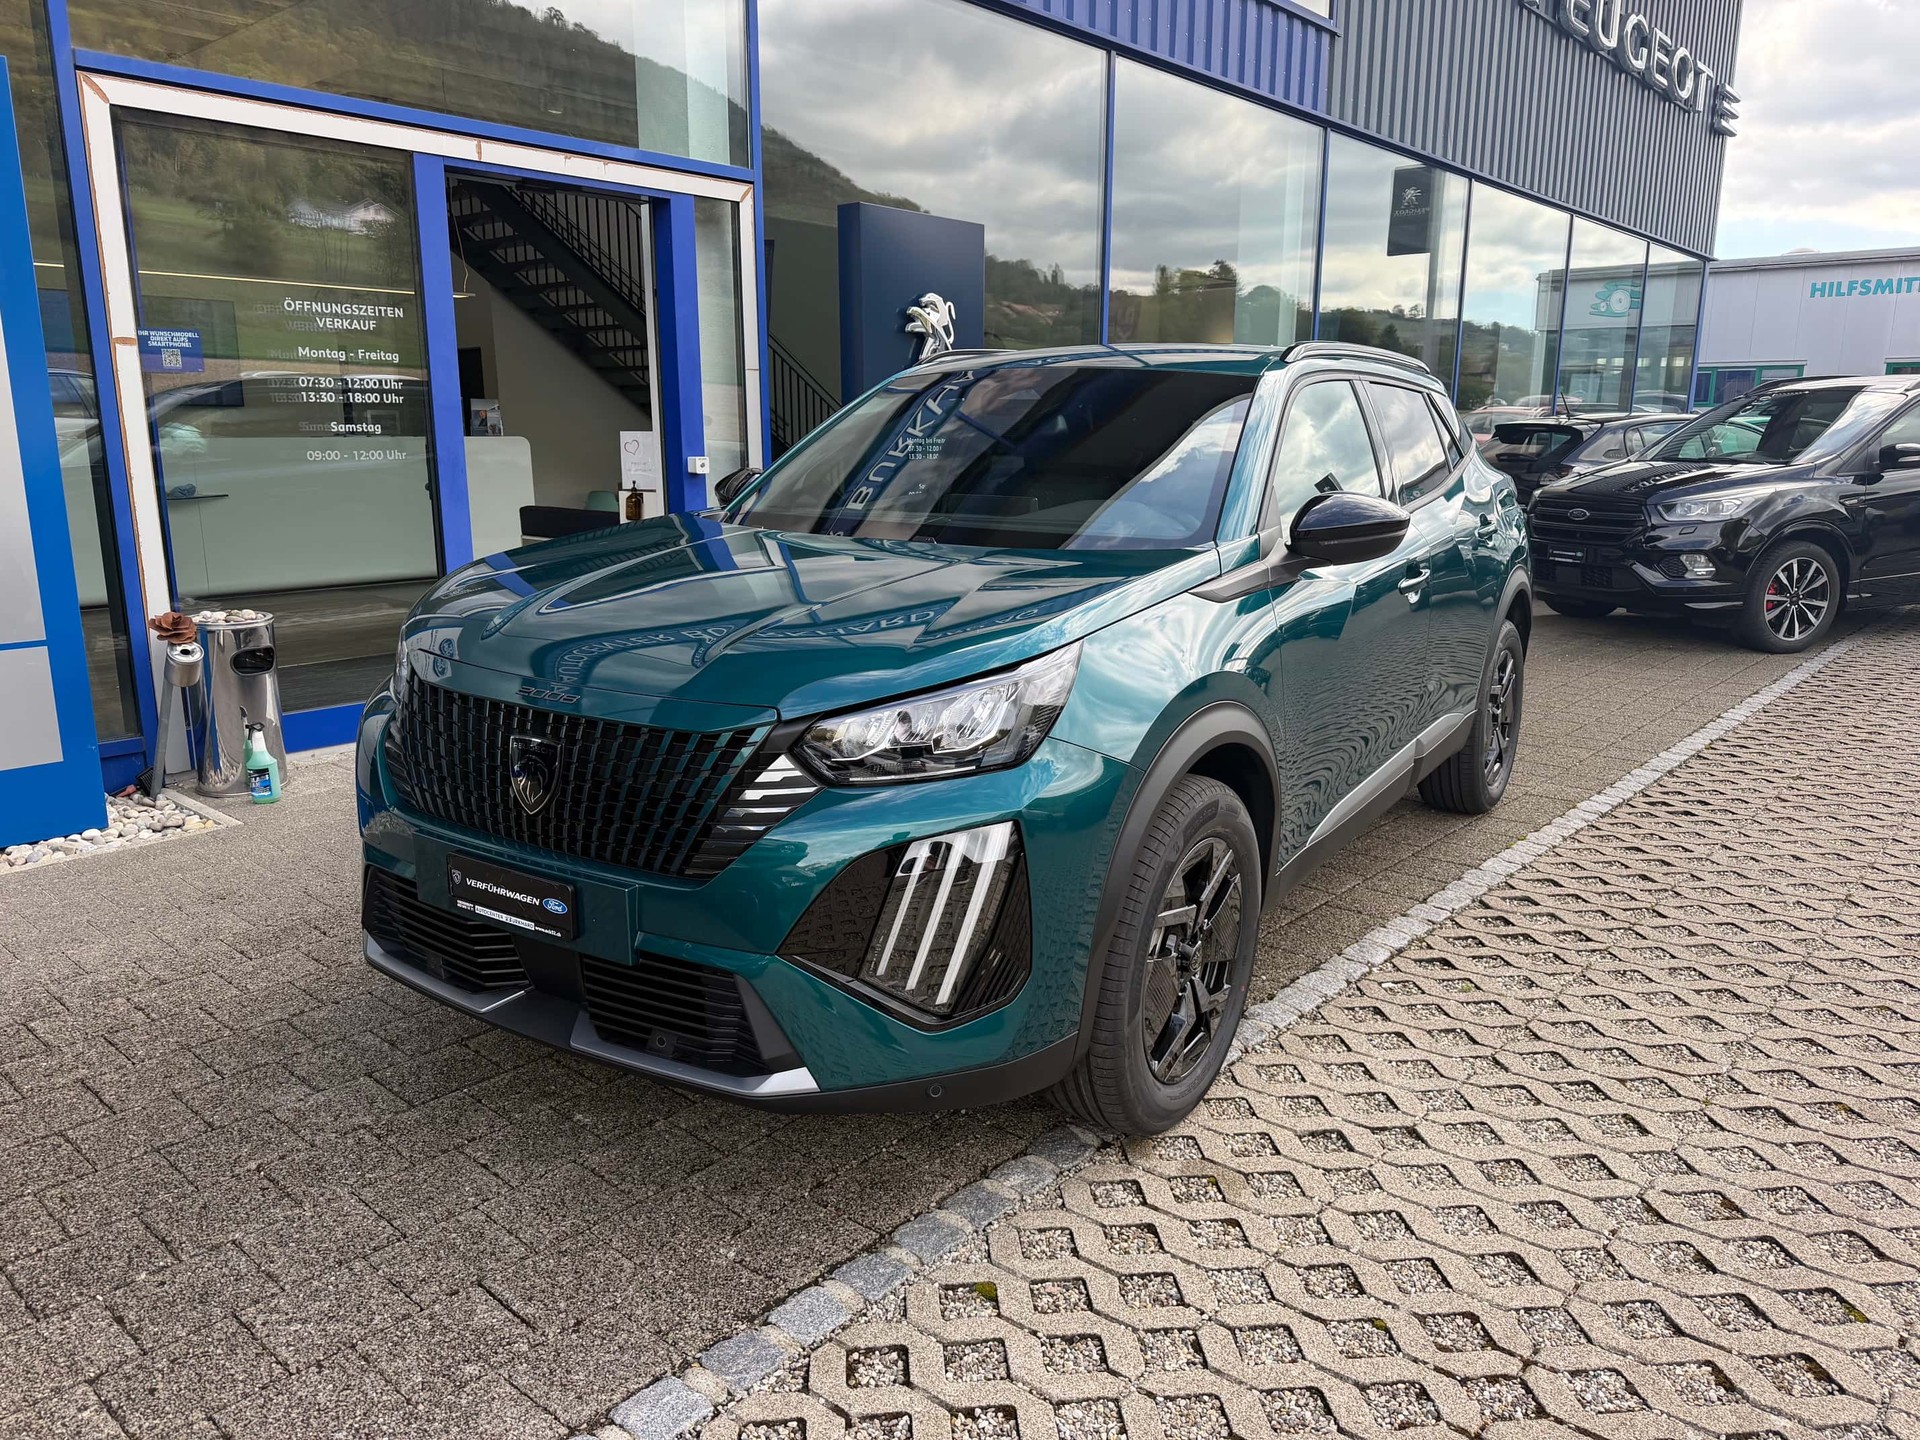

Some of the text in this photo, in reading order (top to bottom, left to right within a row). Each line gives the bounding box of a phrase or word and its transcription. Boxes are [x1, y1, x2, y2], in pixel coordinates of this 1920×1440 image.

[1520, 0, 1714, 112] EUGEOT
[284, 297, 404, 318] ÖFFNUNGSZEITEN
[316, 317, 377, 331] VERKAUF
[298, 346, 346, 361] Montag
[358, 349, 399, 363] Freitag
[299, 377, 334, 388] 07:30
[347, 378, 379, 389] 12:00
[382, 379, 403, 390] Uhr
[301, 391, 336, 403] 13:30
[348, 393, 380, 403] 18:00
[383, 393, 404, 404] Uhr
[330, 421, 382, 434] Samstag
[306, 450, 340, 461] 09:00
[353, 450, 384, 461] 12:00
[386, 450, 407, 460] Uhr
[515, 685, 581, 704] 2008
[466, 878, 540, 906] VERFÜHRWAGEN
